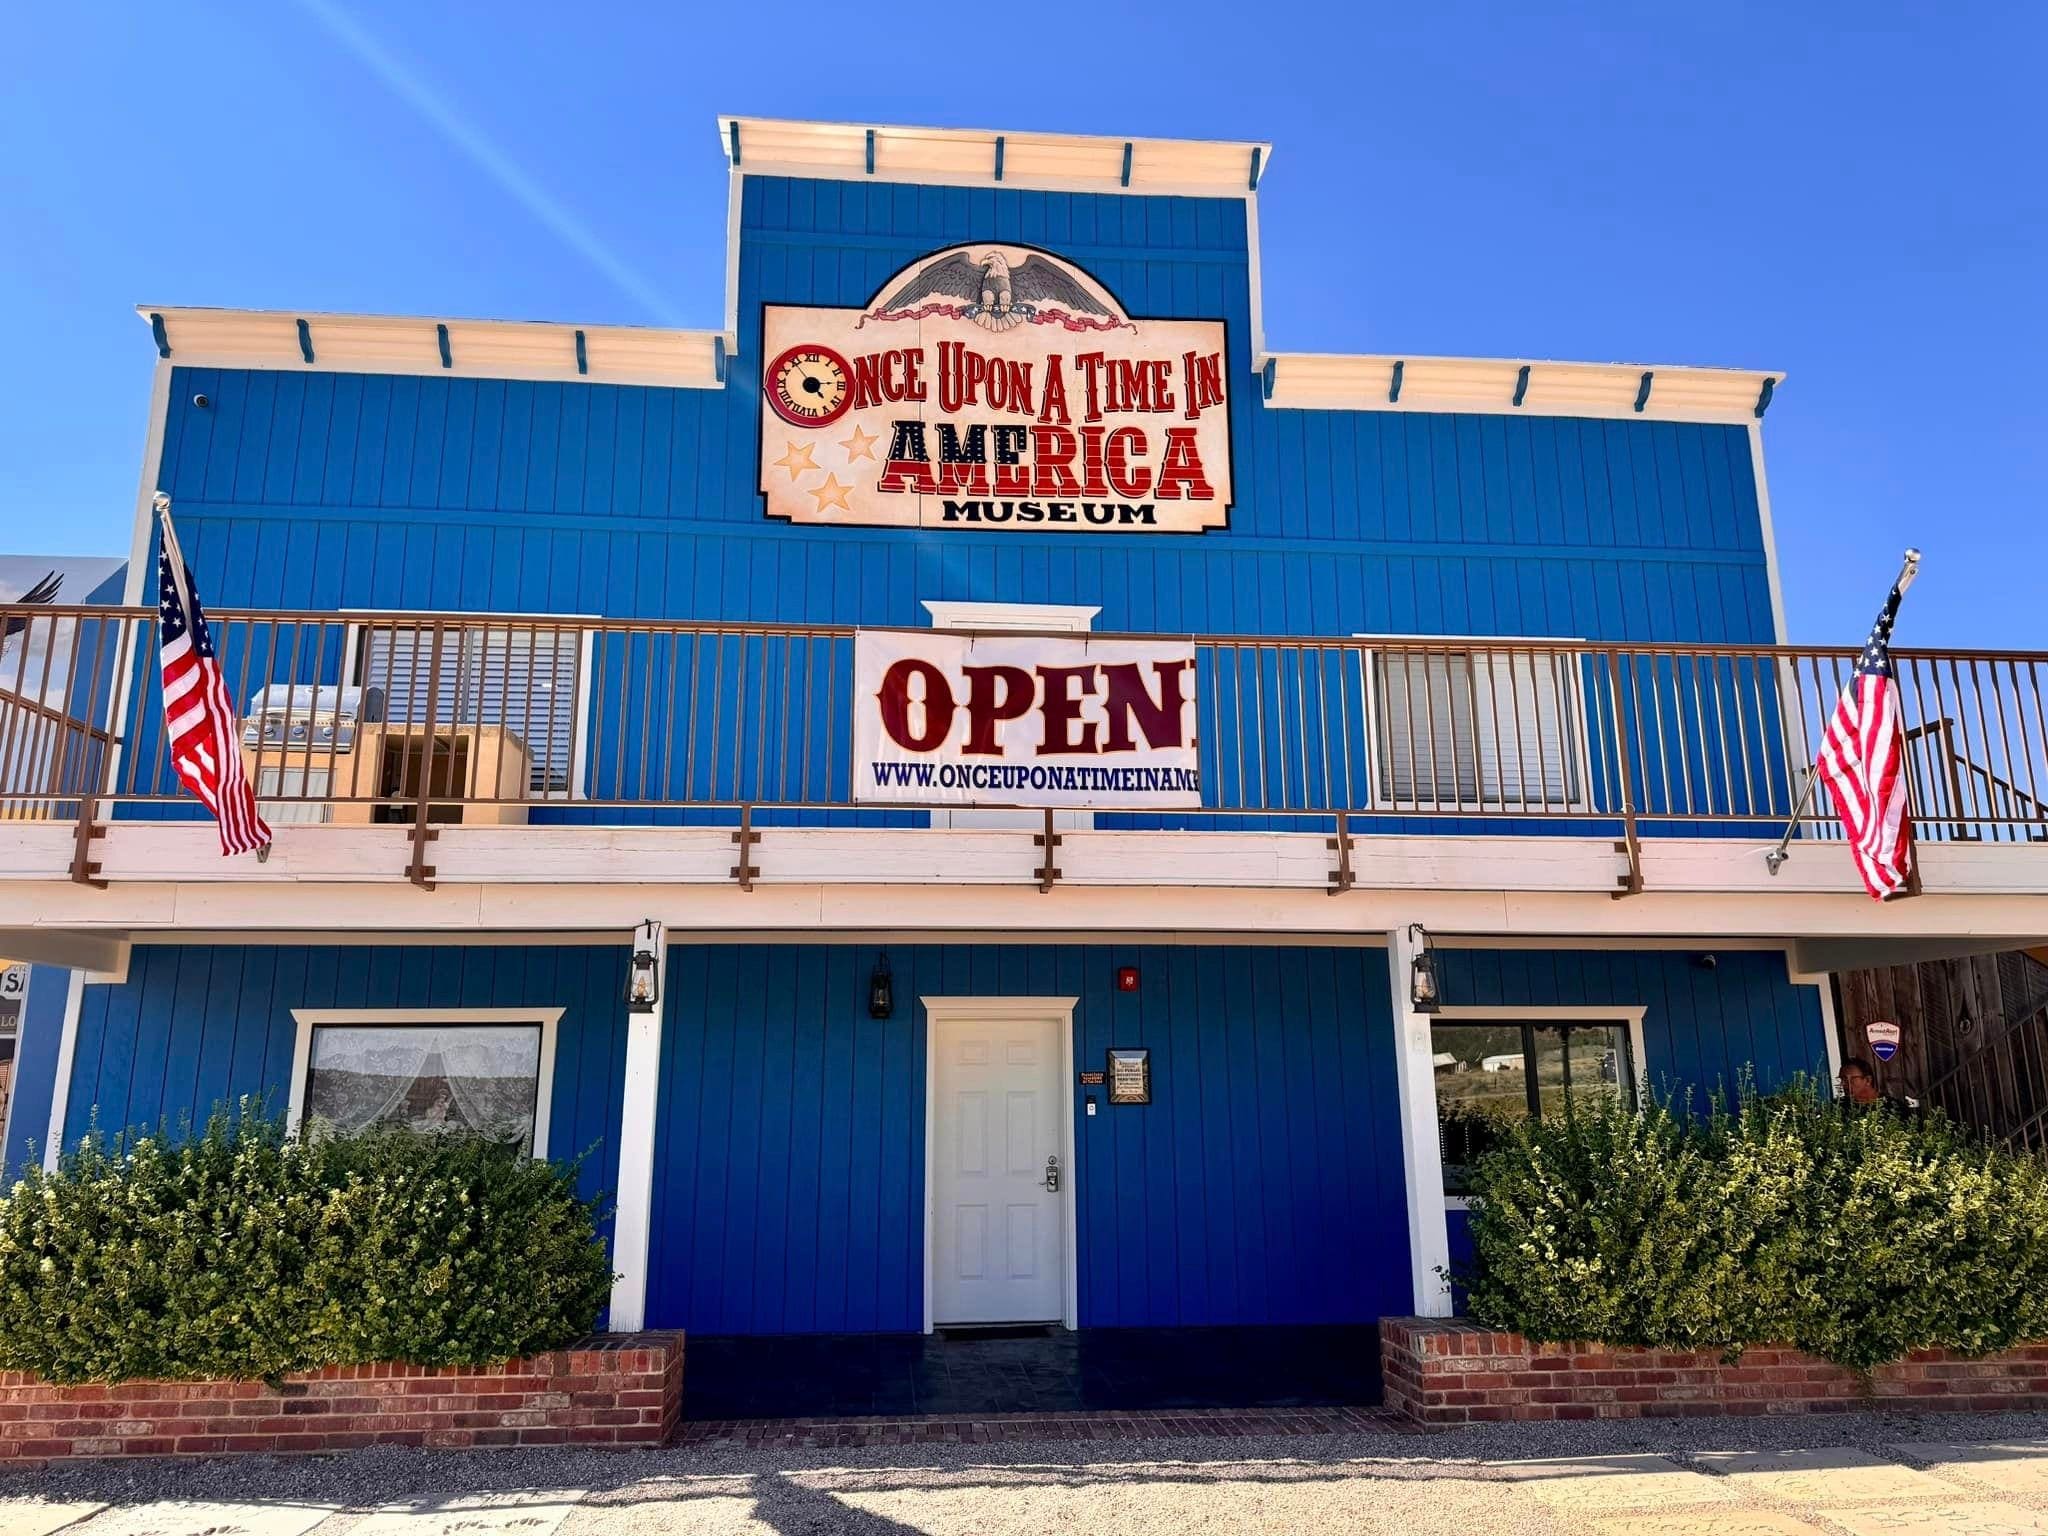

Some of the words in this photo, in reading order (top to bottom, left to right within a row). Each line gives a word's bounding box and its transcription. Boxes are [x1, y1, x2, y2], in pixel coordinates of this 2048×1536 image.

[937, 341, 1034, 415] UPON
[1039, 354, 1072, 425] A
[1076, 351, 1174, 423] TIME
[1183, 350, 1224, 421] IN
[877, 419, 1215, 500] AMERICA
[942, 501, 1158, 524] MUSEUM
[874, 658, 1196, 755] OPEN
